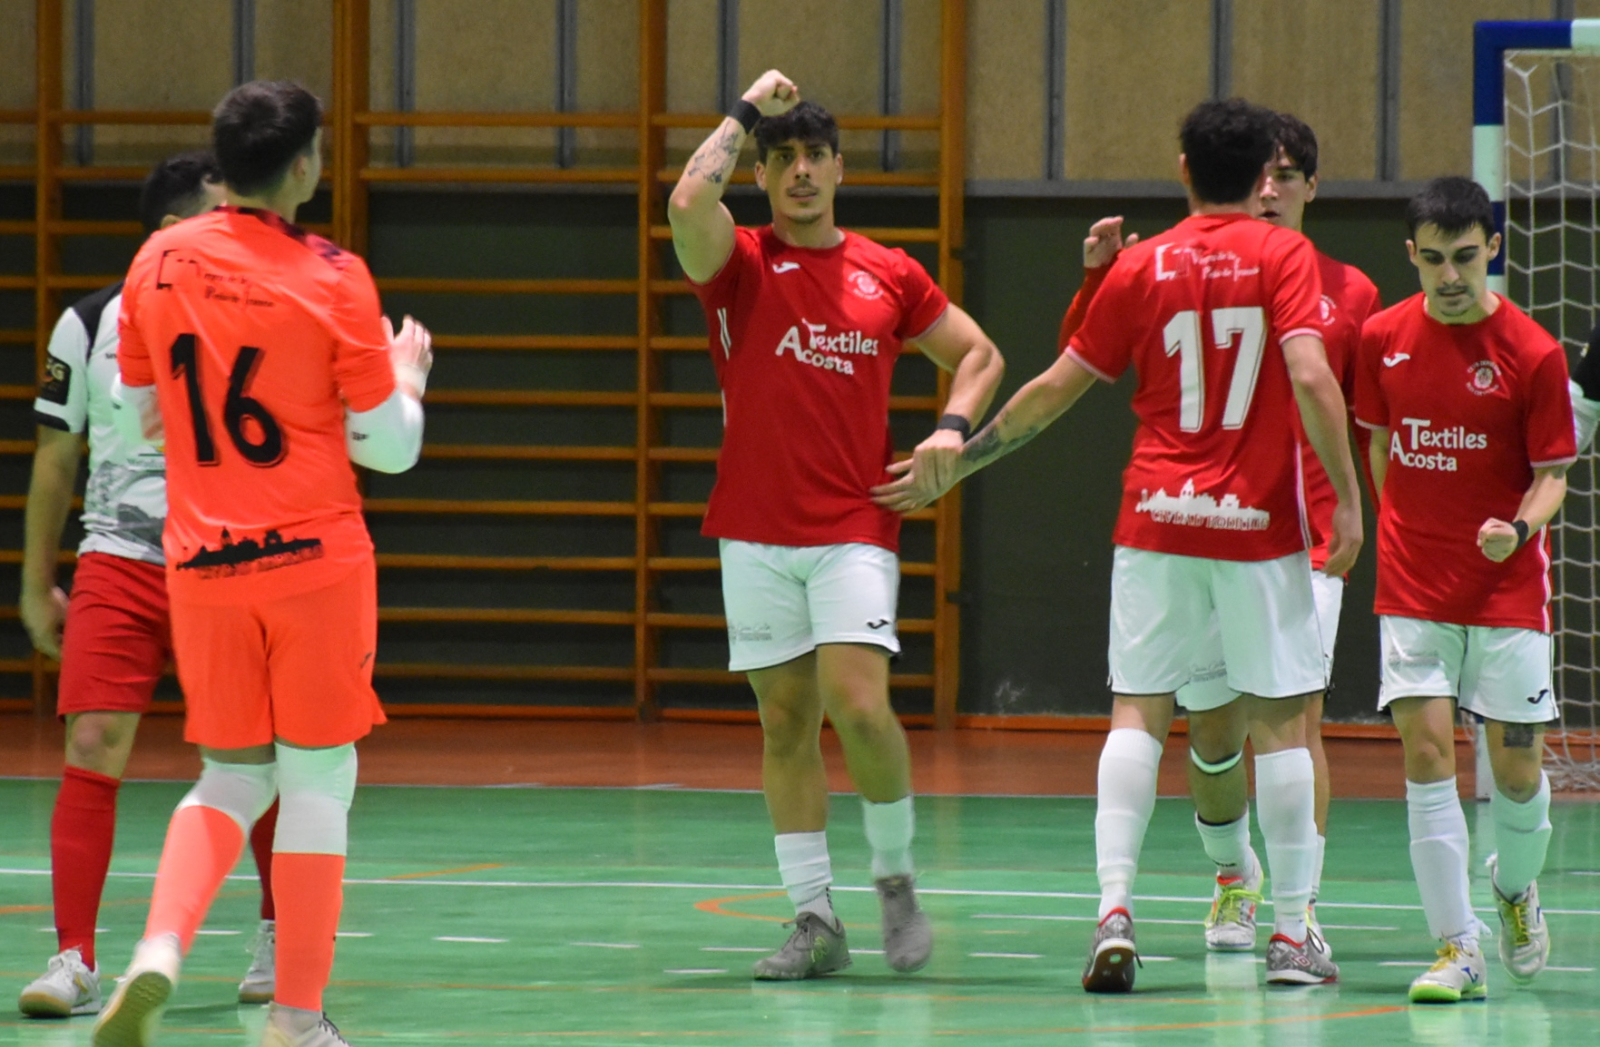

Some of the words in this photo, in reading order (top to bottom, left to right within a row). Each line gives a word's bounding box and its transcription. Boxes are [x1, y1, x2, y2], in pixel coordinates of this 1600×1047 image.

[775, 325, 855, 375] Acosta
[801, 317, 879, 356] Textiles
[1163, 306, 1268, 433] 17
[170, 333, 289, 467] 16
[1389, 431, 1458, 471] Acosta
[1402, 417, 1487, 450] Textiles
